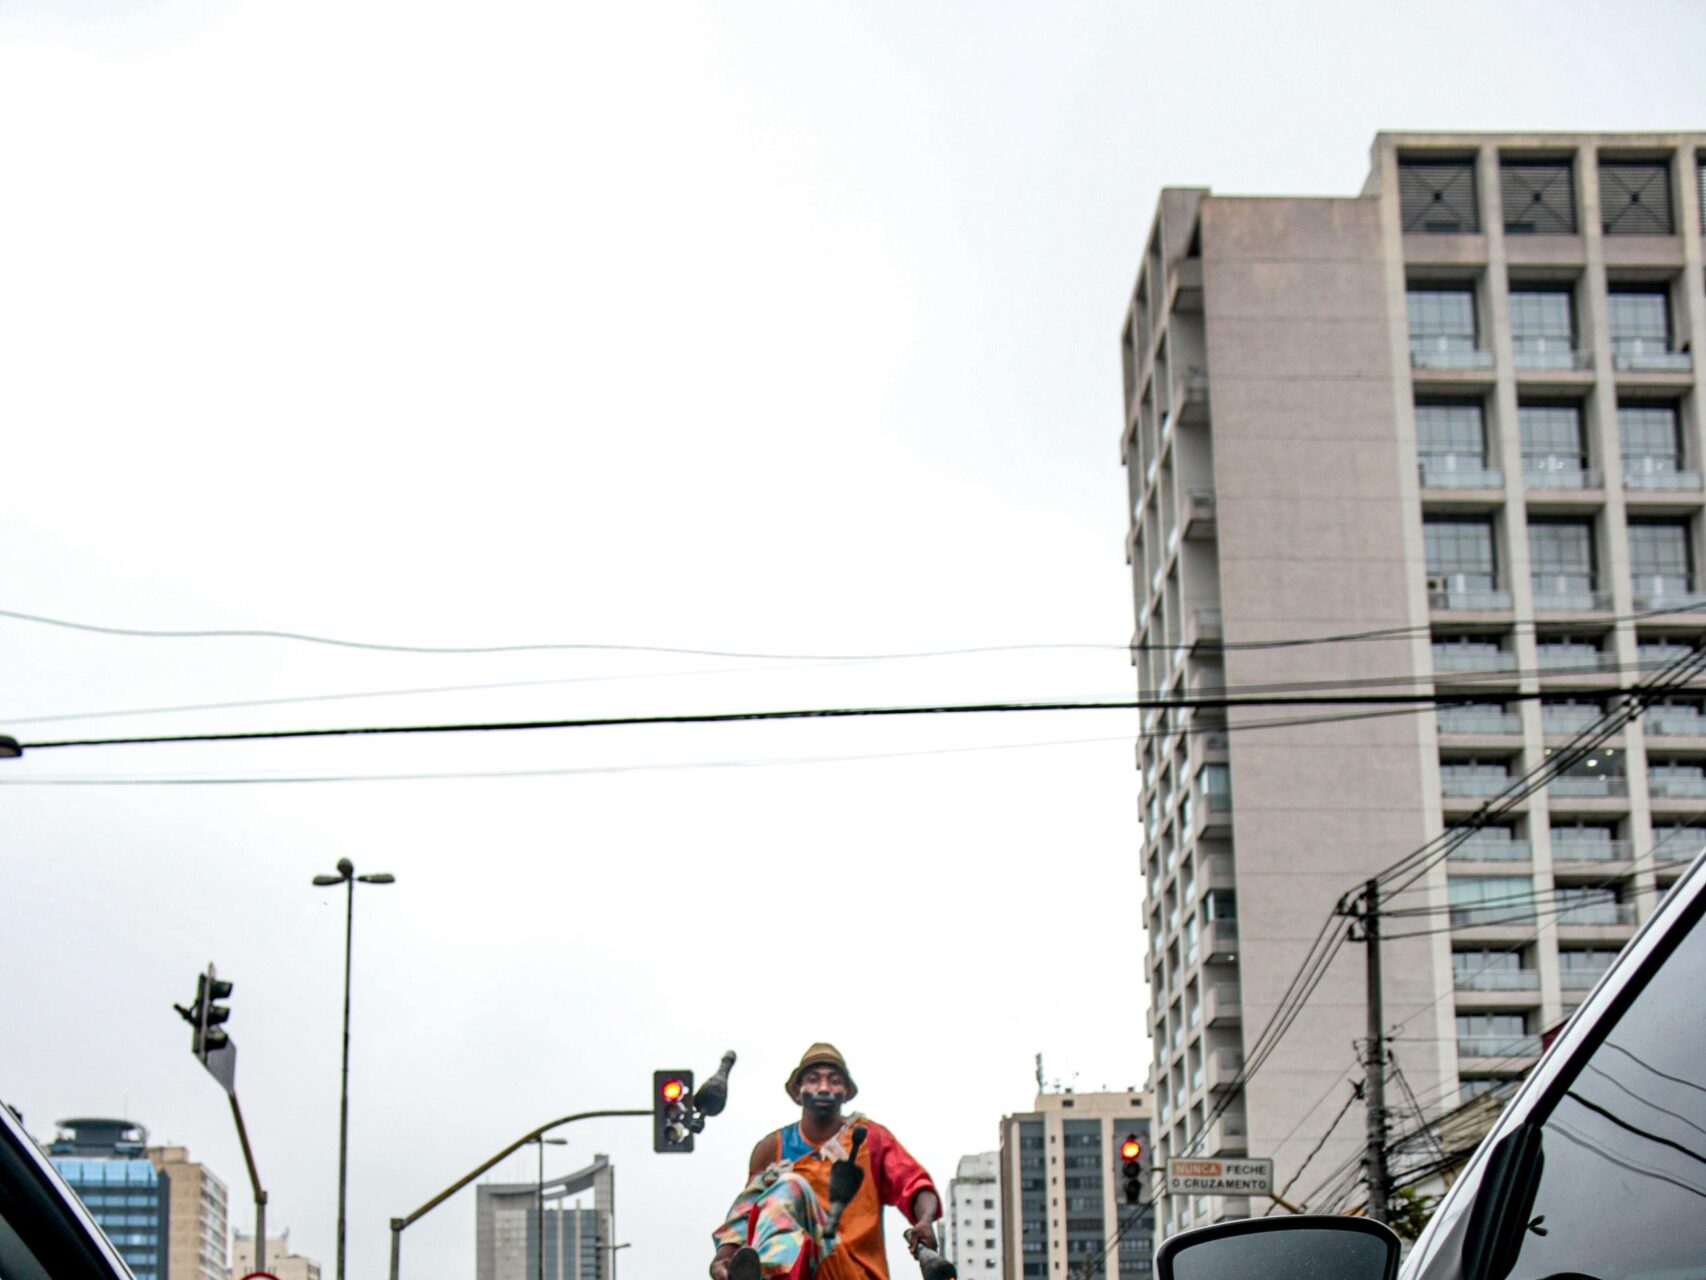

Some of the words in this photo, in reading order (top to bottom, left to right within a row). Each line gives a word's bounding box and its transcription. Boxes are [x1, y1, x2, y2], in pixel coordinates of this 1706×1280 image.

[1176, 1164, 1218, 1174] NUNCA
[1226, 1165, 1266, 1175] FECHE
[1172, 1178, 1180, 1187] O
[1184, 1178, 1266, 1189] CRUZAMENTO
